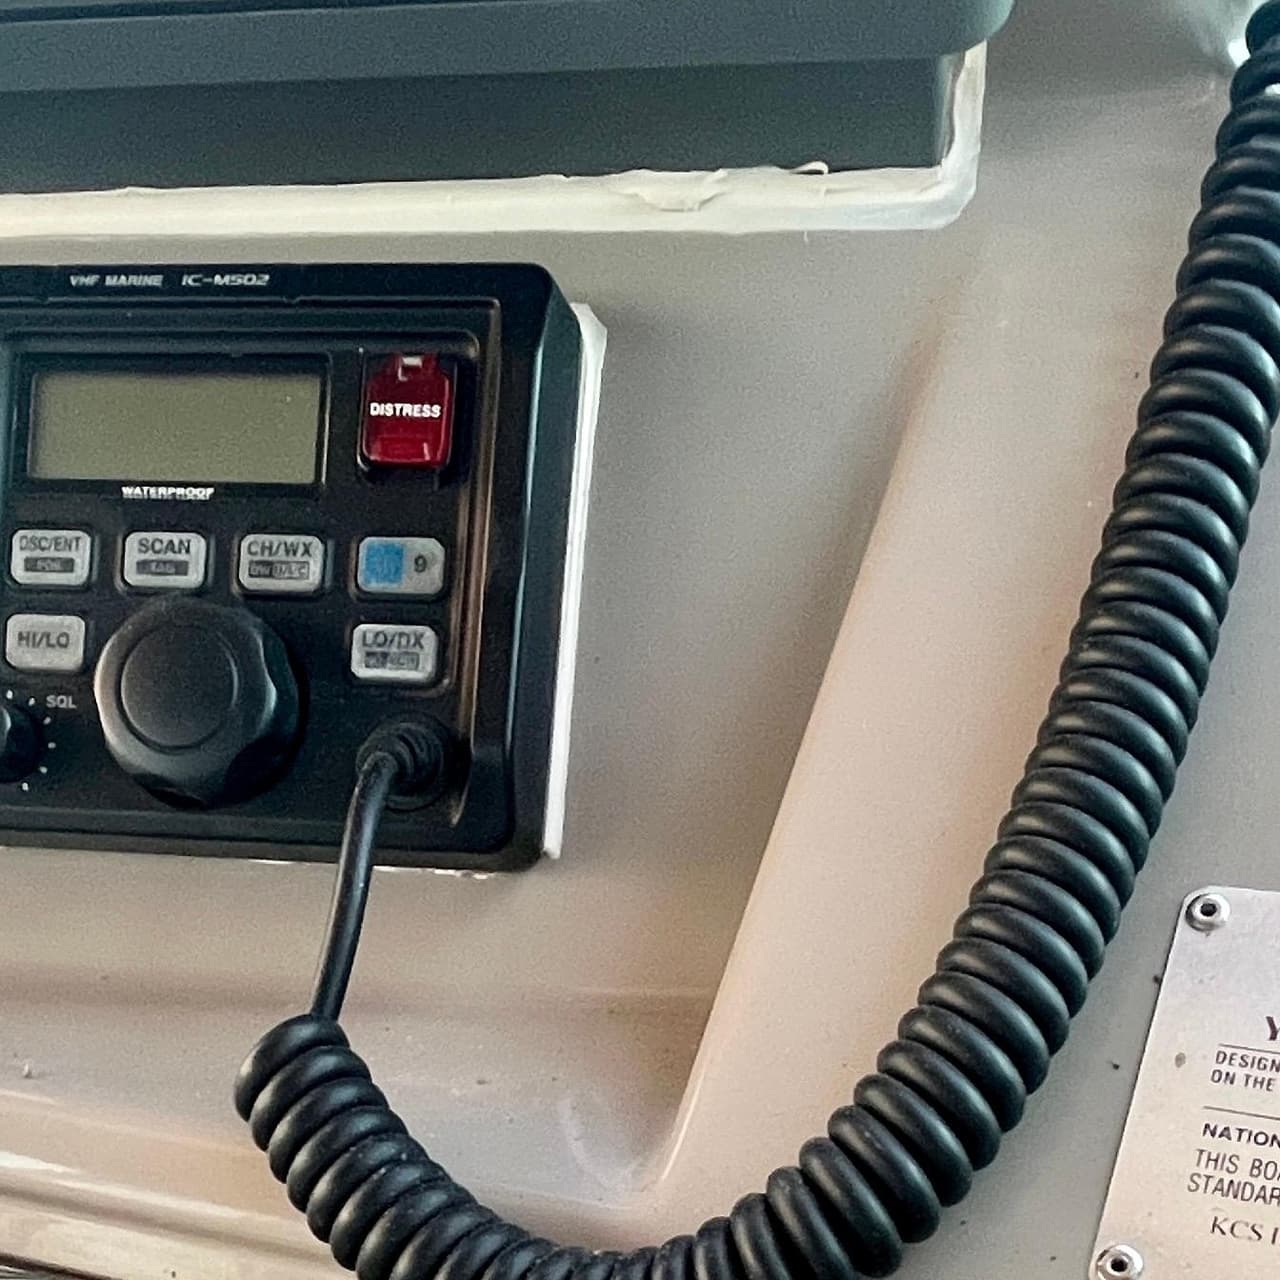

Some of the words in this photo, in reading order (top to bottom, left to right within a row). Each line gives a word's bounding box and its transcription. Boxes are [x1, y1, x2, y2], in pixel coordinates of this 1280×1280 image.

[70, 275, 99, 286] VHF
[105, 274, 163, 286] MARINE
[181, 274, 270, 286] IC-M502
[370, 402, 441, 418] DISTRESS
[121, 486, 214, 500] WATERPROOF
[19, 535, 81, 551] DSC/ENT
[138, 537, 191, 554] SCAN
[247, 540, 313, 558] CH/WX
[414, 555, 427, 573] 9
[18, 631, 70, 649] HI/LO
[362, 631, 425, 649] LO/DX
[46, 695, 76, 708] SQL
[1211, 1069, 1236, 1086] ON
[1243, 1073, 1275, 1092] THE
[1196, 1149, 1239, 1174] THIS
[1210, 1215, 1264, 1242] KCS
